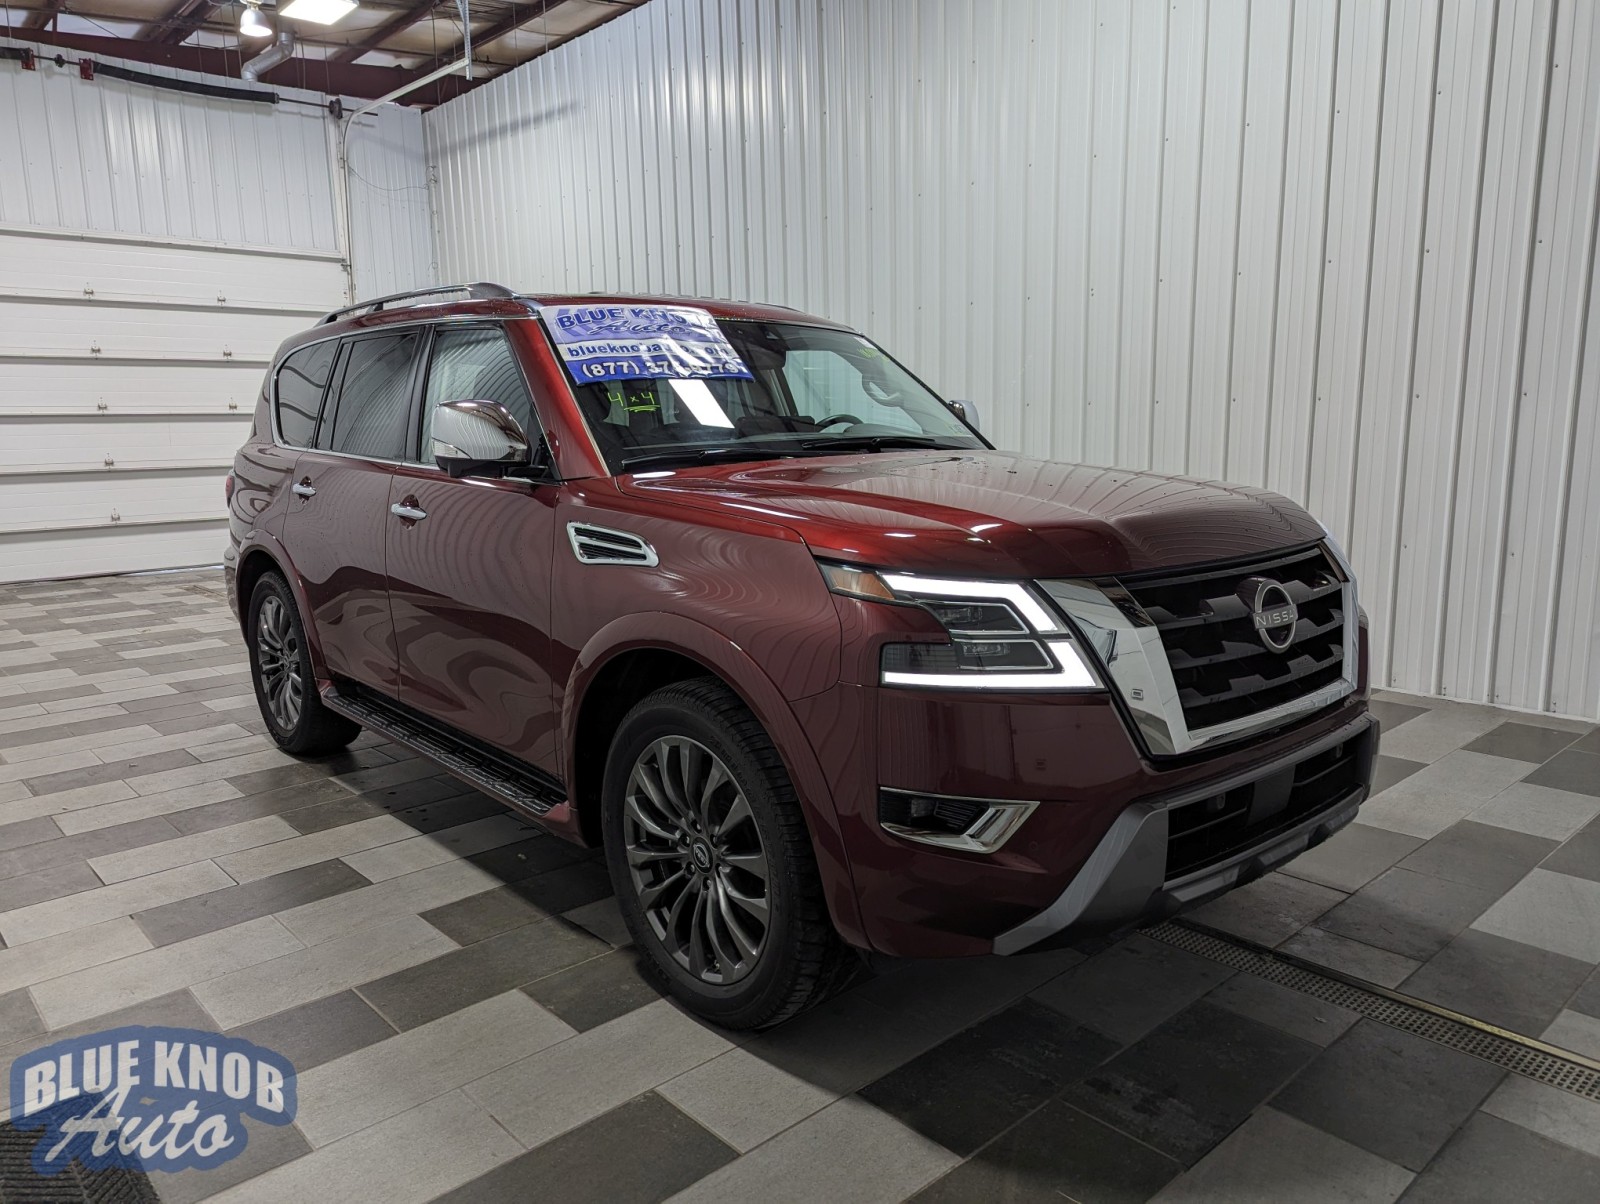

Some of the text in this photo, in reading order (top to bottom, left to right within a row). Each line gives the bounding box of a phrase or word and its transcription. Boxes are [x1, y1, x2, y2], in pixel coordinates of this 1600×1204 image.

[557, 308, 706, 331] BLUE KNO
[586, 320, 692, 336] Auto
[582, 360, 639, 378] (877)
